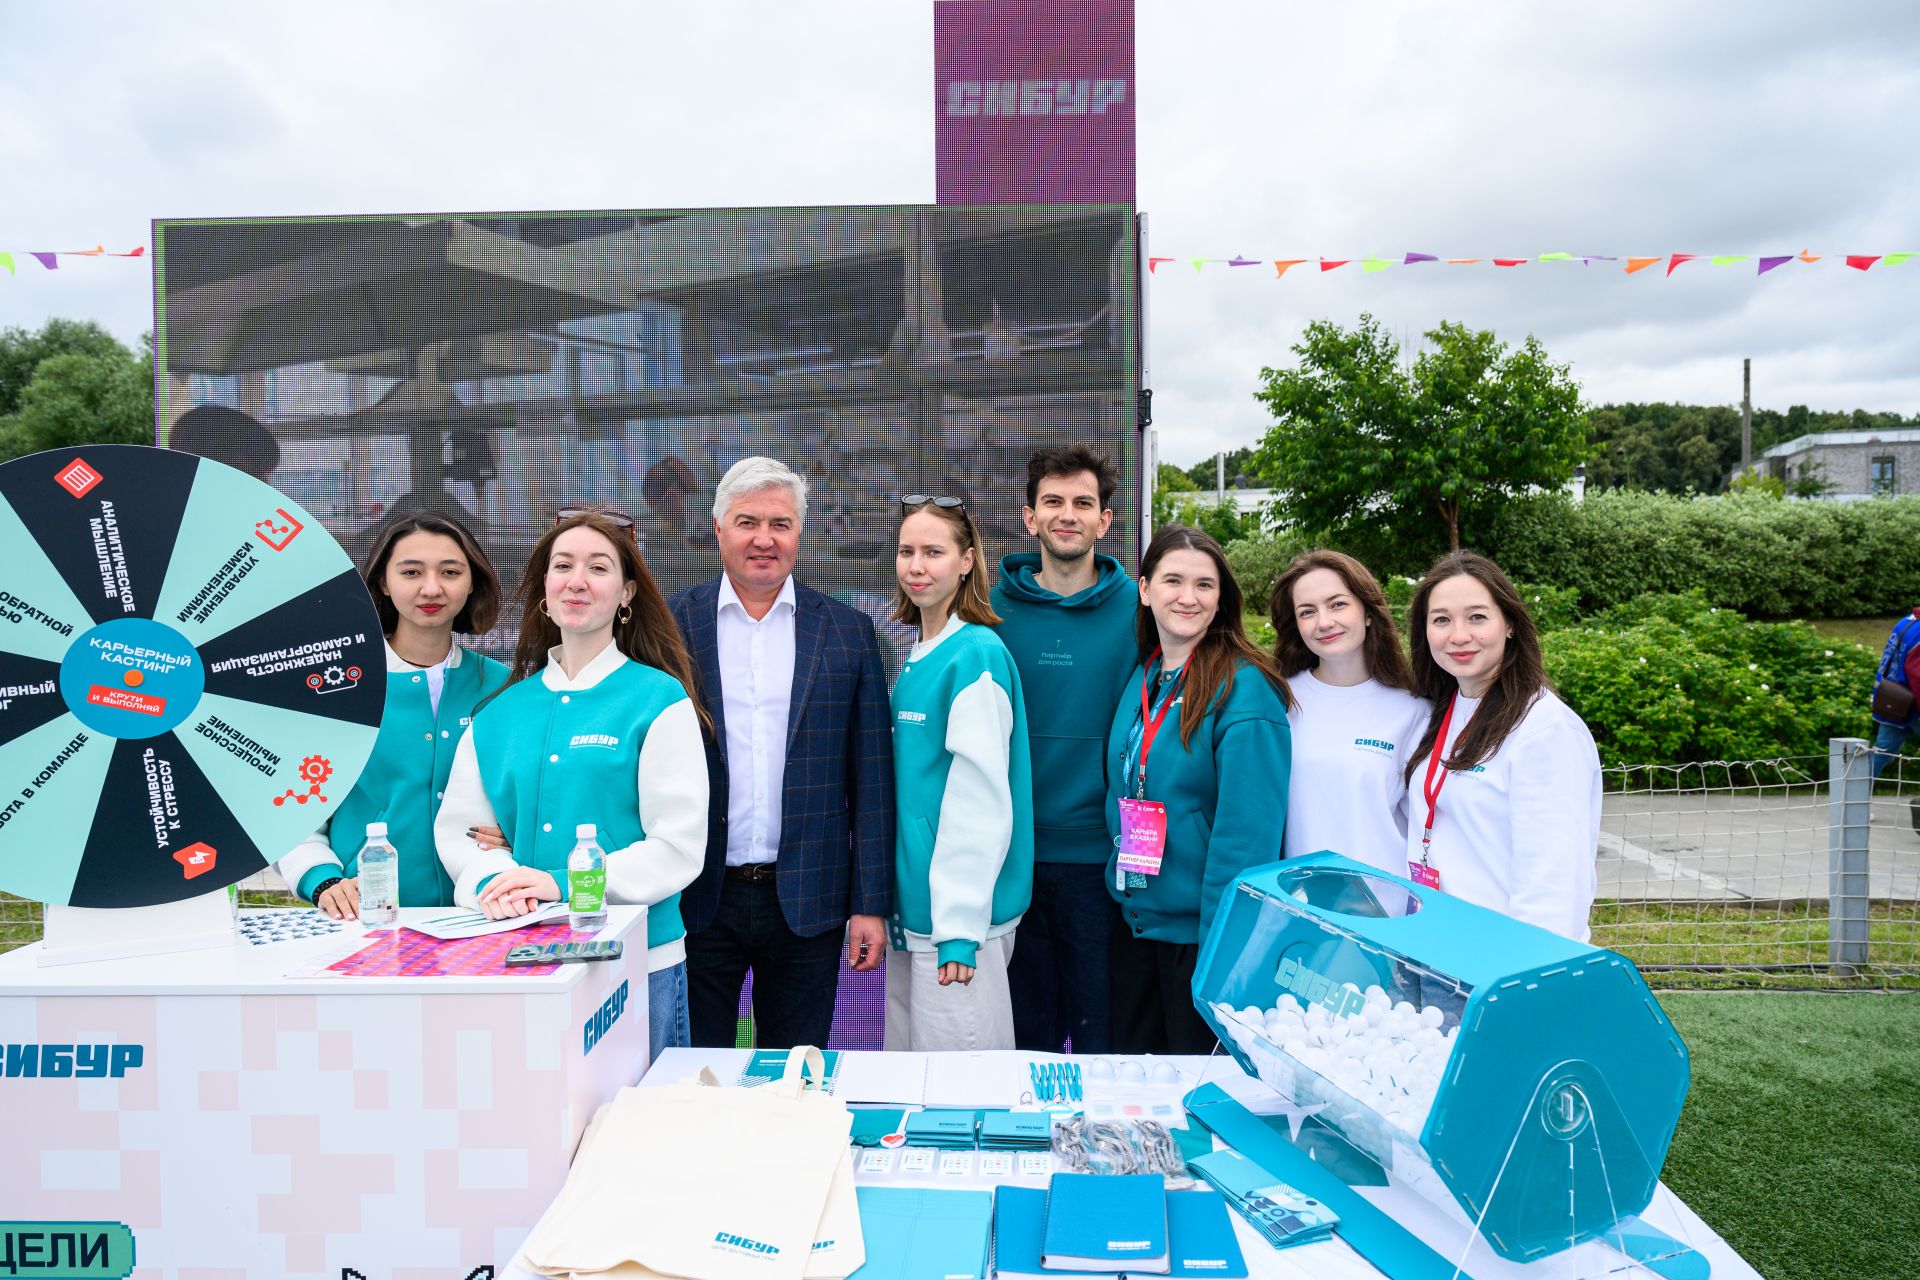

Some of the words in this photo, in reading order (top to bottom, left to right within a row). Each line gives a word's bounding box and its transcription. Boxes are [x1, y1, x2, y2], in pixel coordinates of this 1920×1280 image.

[947, 79, 1126, 115] СИБУР
[90, 518, 117, 598] МЫШЛЕНИЕ
[101, 500, 135, 612] АНАЛИТИЧЕСКОЕ
[177, 541, 254, 623] ИЗМЕНЕНИЯМИ
[193, 556, 259, 624] УПРАВЛЕНИЕ
[0, 591, 74, 637] ОБРАТНОЙ
[89, 637, 192, 667] КАРЬЕРНЫЙ
[211, 636, 351, 673] САМООРГАНИЗАЦИЯ
[355, 633, 366, 644] И
[100, 651, 176, 674] КАСТИНГ
[246, 650, 343, 677] НАДЕЖНОСТЬ
[103, 696, 160, 713] ВЫПОЛНЯЙ
[109, 691, 143, 703] КРУТИ
[194, 722, 277, 777] ПРОЦЕССНОЕ
[207, 715, 281, 765] МЫШЛЕНИЕ
[570, 734, 619, 746] СИБУР
[1354, 738, 1395, 751] СИБУР
[21, 788, 35, 799] В
[31, 732, 89, 788] КОМАНДЕ
[143, 748, 169, 849] УСТОЙЧИВОСТЬ
[159, 760, 178, 817] СТРЕССУ
[168, 820, 180, 830] К
[1274, 957, 1366, 1020] СИБУР
[583, 978, 628, 1056] СИБУР
[0, 1044, 144, 1078] ИБУР
[715, 1232, 780, 1254] СИБУР
